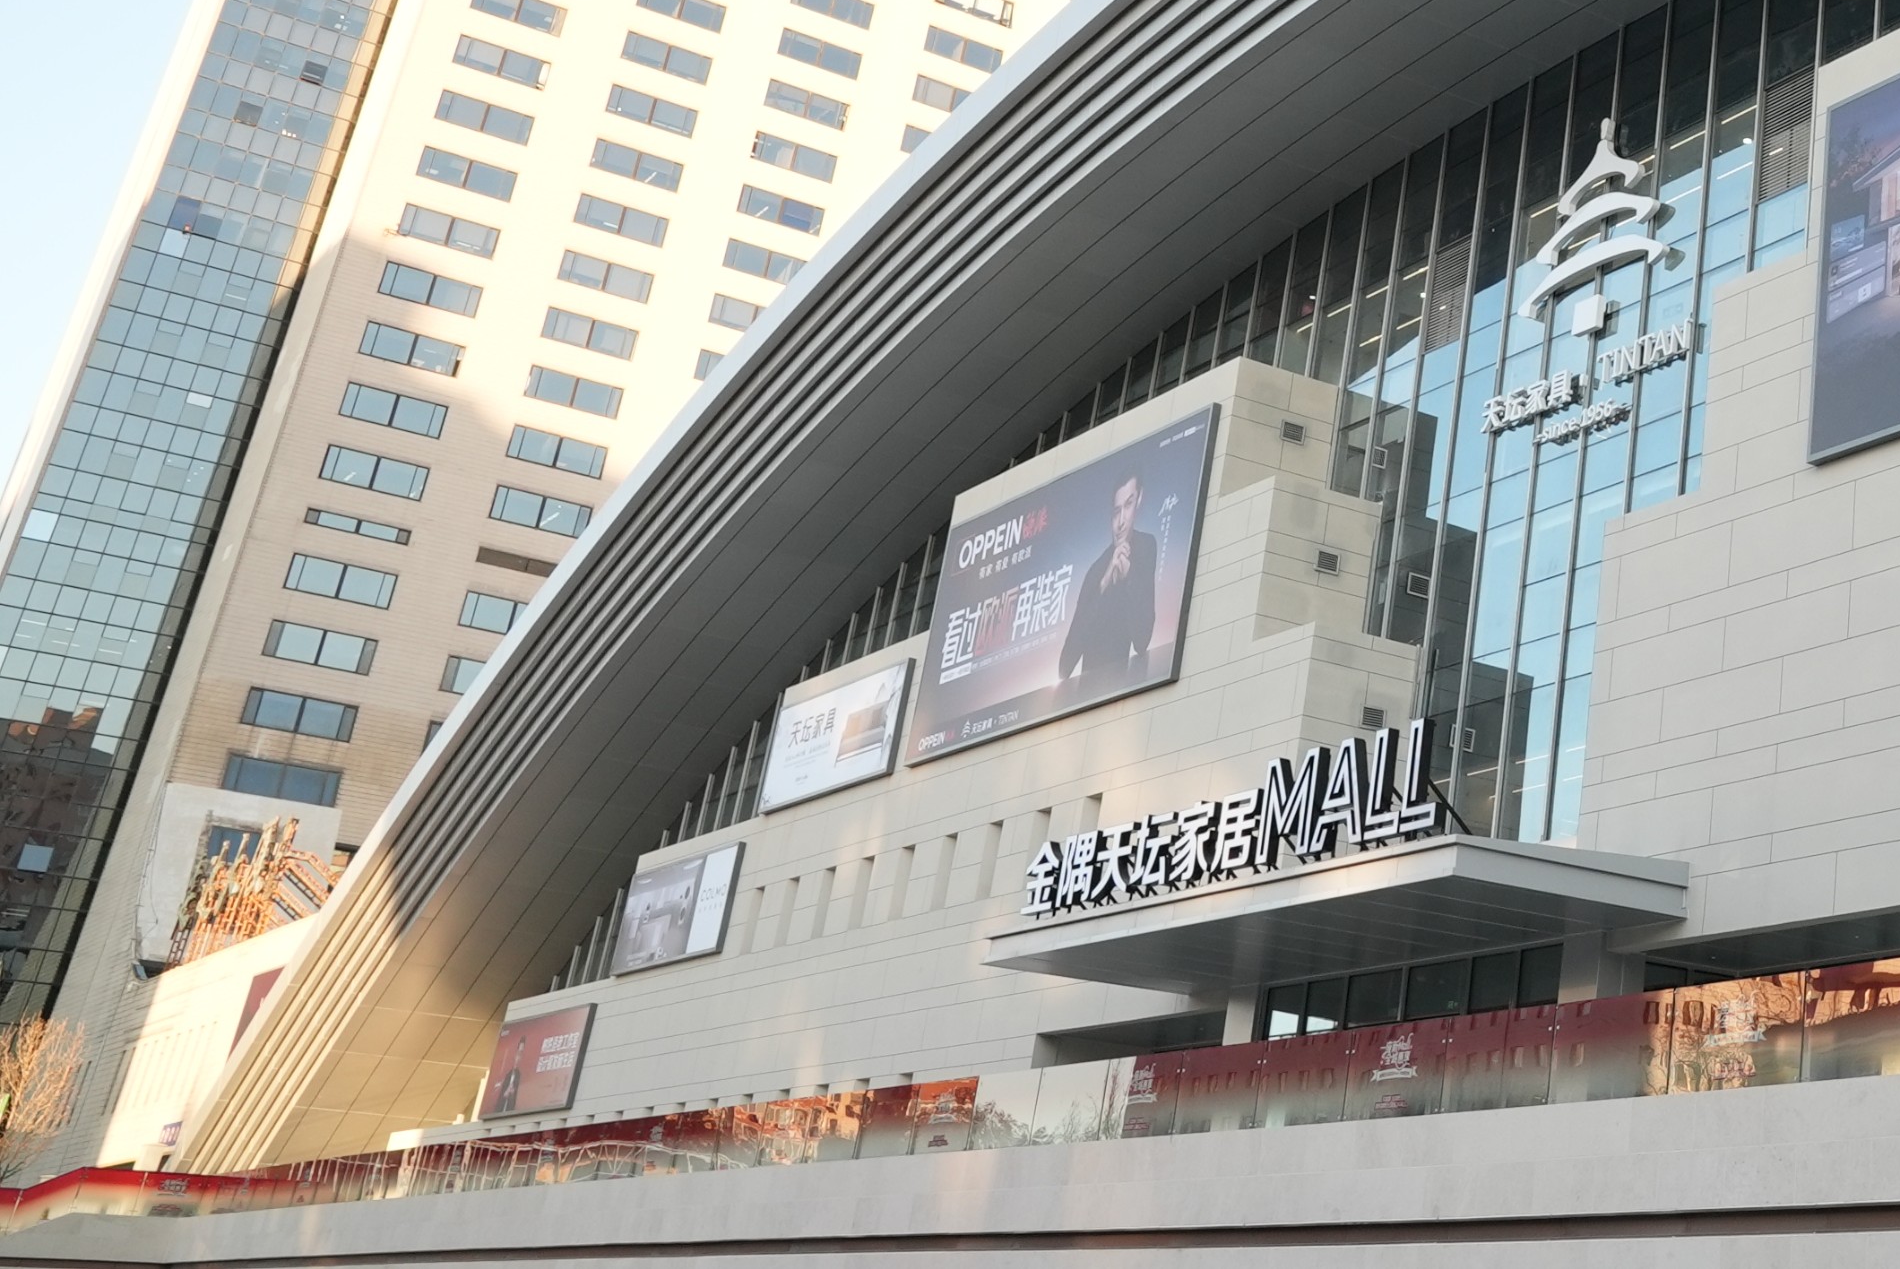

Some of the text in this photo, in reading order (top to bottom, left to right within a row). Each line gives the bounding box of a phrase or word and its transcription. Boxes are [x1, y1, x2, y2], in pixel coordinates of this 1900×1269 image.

[1480, 317, 1695, 434] 天坛家具 TINTAN
[958, 515, 1024, 570] OPPEIN
[787, 706, 837, 749] 天坛家具
[917, 730, 946, 752] OPPEIN
[699, 883, 728, 903] COLMO
